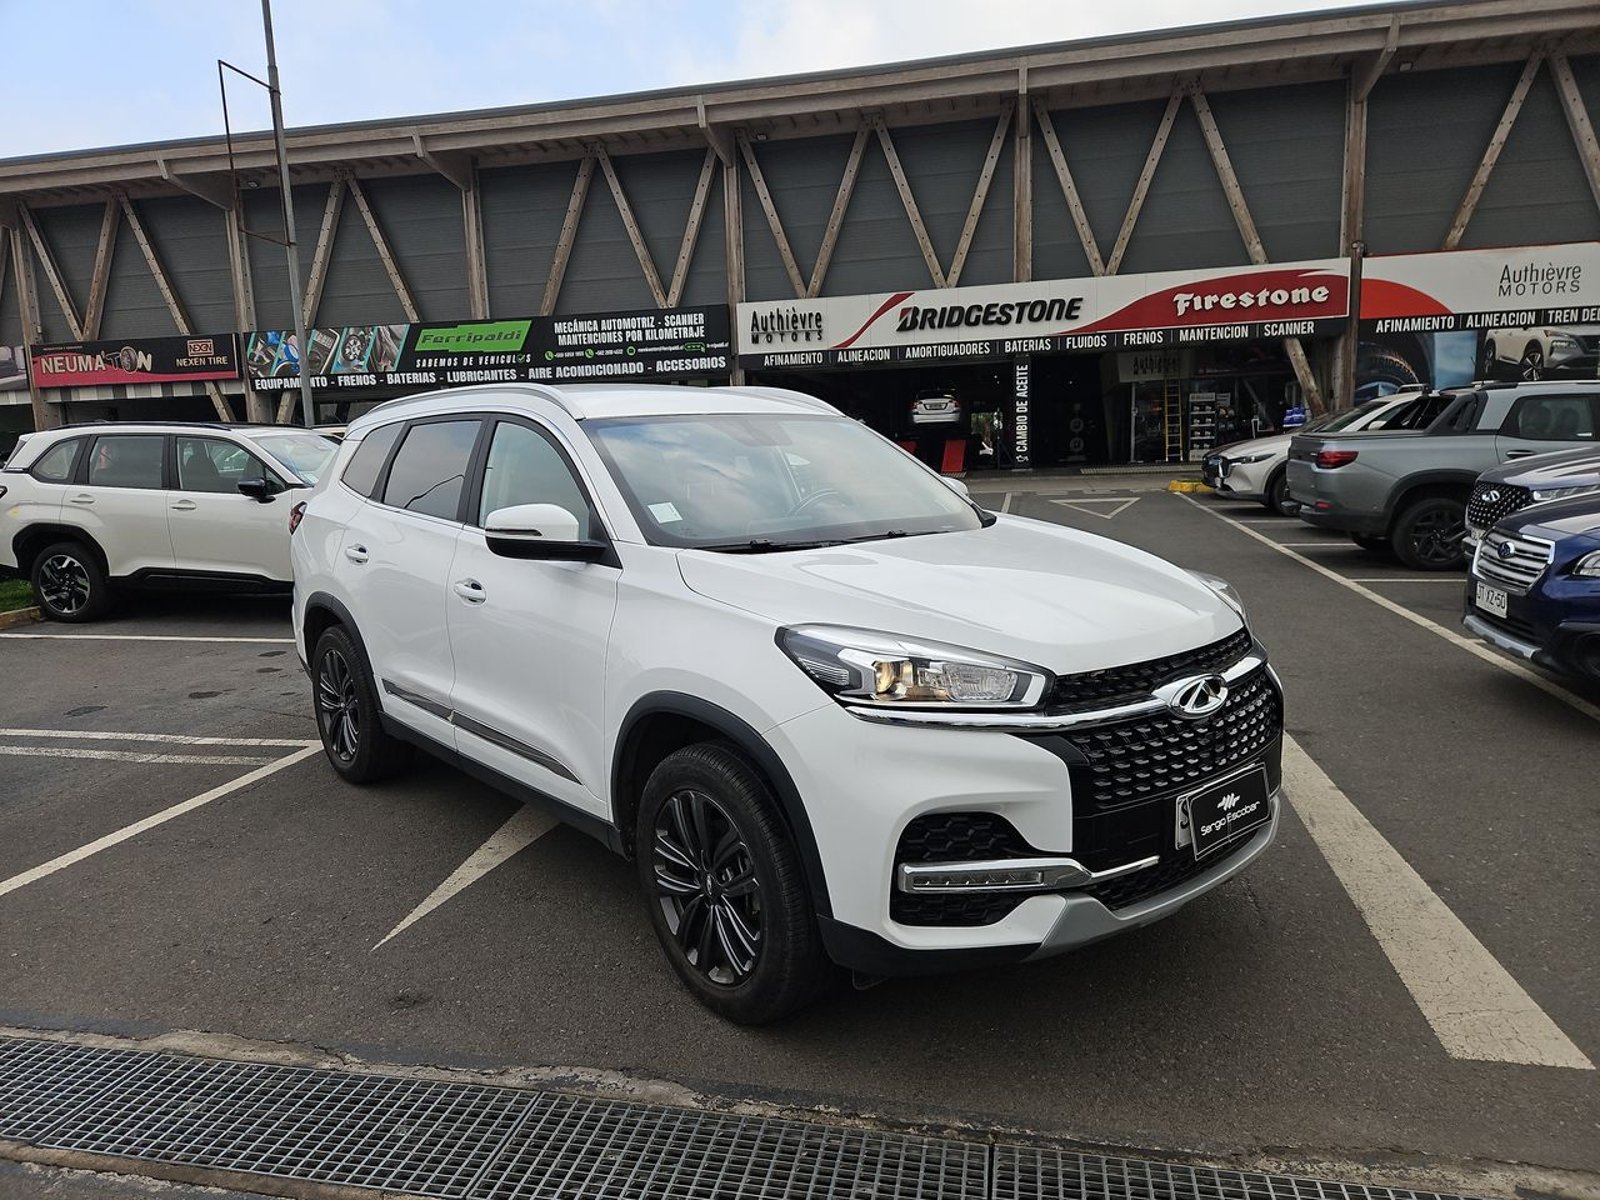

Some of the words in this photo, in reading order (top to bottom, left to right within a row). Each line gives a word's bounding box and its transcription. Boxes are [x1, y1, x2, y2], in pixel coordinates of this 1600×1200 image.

[1500, 263, 1582, 284] Authièvre
[1498, 280, 1580, 297] MOTORS
[1173, 285, 1329, 317] Firestone
[554, 318, 599, 334] MECÁNICA
[601, 316, 655, 331] AUTOMOTRIZ
[664, 313, 704, 327] SCANNER
[750, 307, 823, 332] Authièvre
[896, 298, 1084, 332] BRIDGESTONE
[1376, 316, 1454, 333] AFINAMIENTO
[1466, 311, 1536, 328] ALINEACION
[1548, 309, 1579, 323] TREN
[421, 330, 521, 344] Ferripaldi
[558, 331, 623, 346] MANTENCIONES
[625, 330, 643, 342] POR
[645, 326, 705, 341] KILOMETRAJE
[751, 329, 823, 344] MOTORS
[764, 352, 823, 367] AFINAMIENTO
[838, 349, 890, 363] ALINEACION
[905, 342, 990, 359] AMORTIGUADORES
[1004, 339, 1051, 353] BATERIAS
[1066, 335, 1107, 349] FLUIDOS
[1123, 331, 1163, 345] FRENOS
[1179, 325, 1249, 342] MANTENCION
[1264, 321, 1315, 336] SCANNER
[176, 357, 206, 367] NEXEN
[207, 355, 228, 365] TIRE
[416, 356, 458, 368] SABEMOS
[463, 355, 474, 366] DE
[255, 377, 328, 390] EQUIPAMNTO
[338, 373, 376, 386] FRENOS
[387, 371, 436, 385] BATERIAS
[447, 369, 517, 382] LUBRICANTES
[528, 367, 552, 379] AIRE
[556, 362, 644, 378] ACONDICIONADO
[656, 356, 726, 372] ACCESORIOS
[1015, 364, 1028, 397] ACEITE
[1015, 400, 1028, 413] DE
[1015, 415, 1028, 452] CAMBIO
[1226, 800, 1260, 823] Escobar
